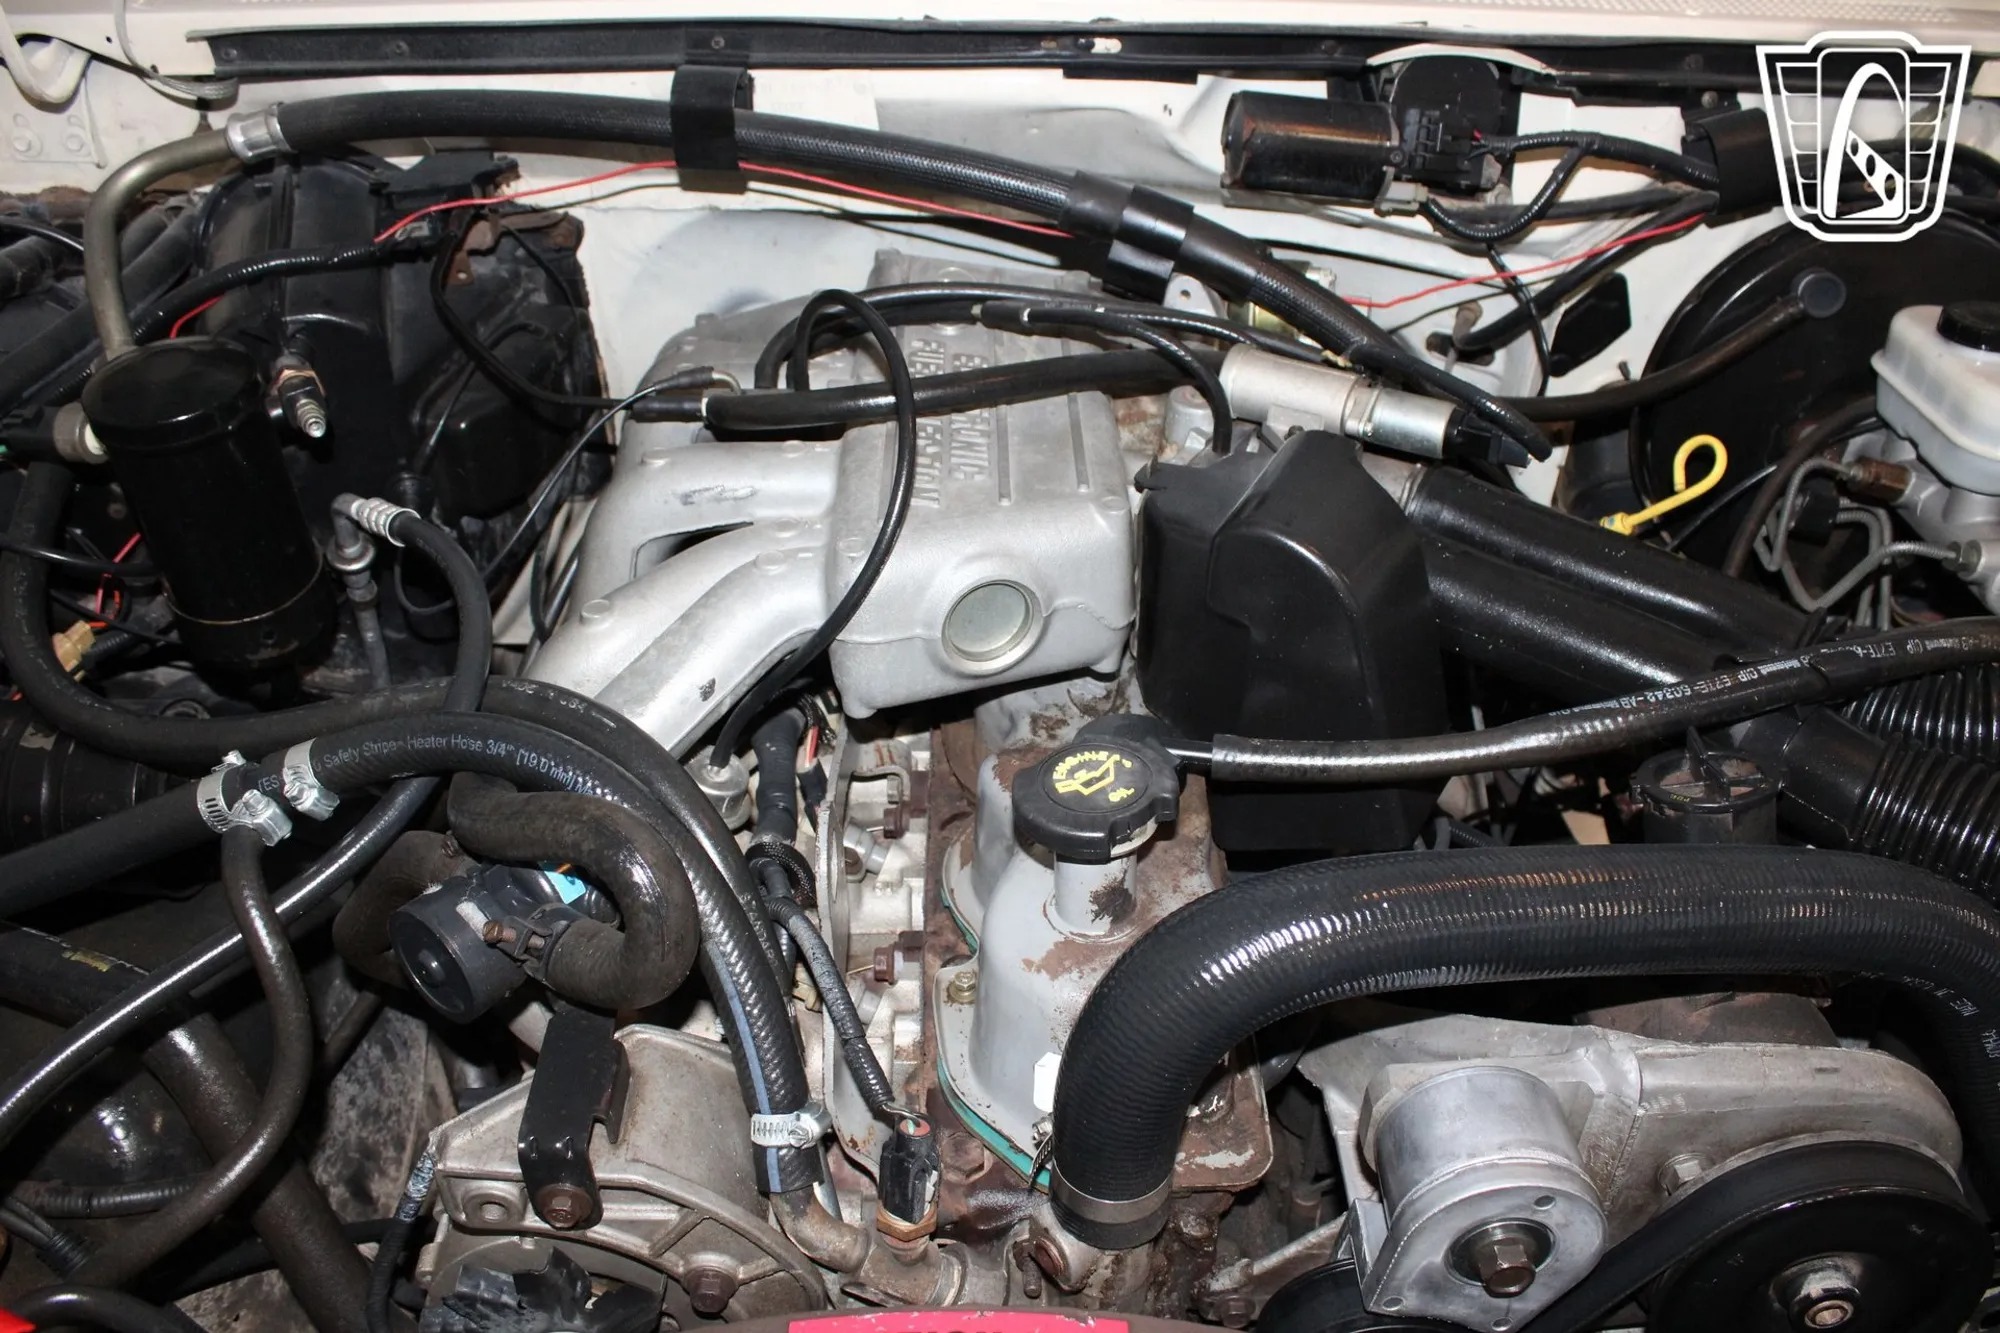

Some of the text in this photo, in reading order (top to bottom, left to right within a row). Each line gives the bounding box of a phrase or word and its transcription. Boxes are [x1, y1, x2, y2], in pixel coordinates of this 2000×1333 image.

[323, 746, 360, 769] Safety
[363, 740, 398, 758] Stripe
[407, 735, 448, 751] Heater
[451, 734, 483, 753] Hose
[1053, 751, 1109, 779] ENGINE
[1108, 788, 1135, 802] OIL
